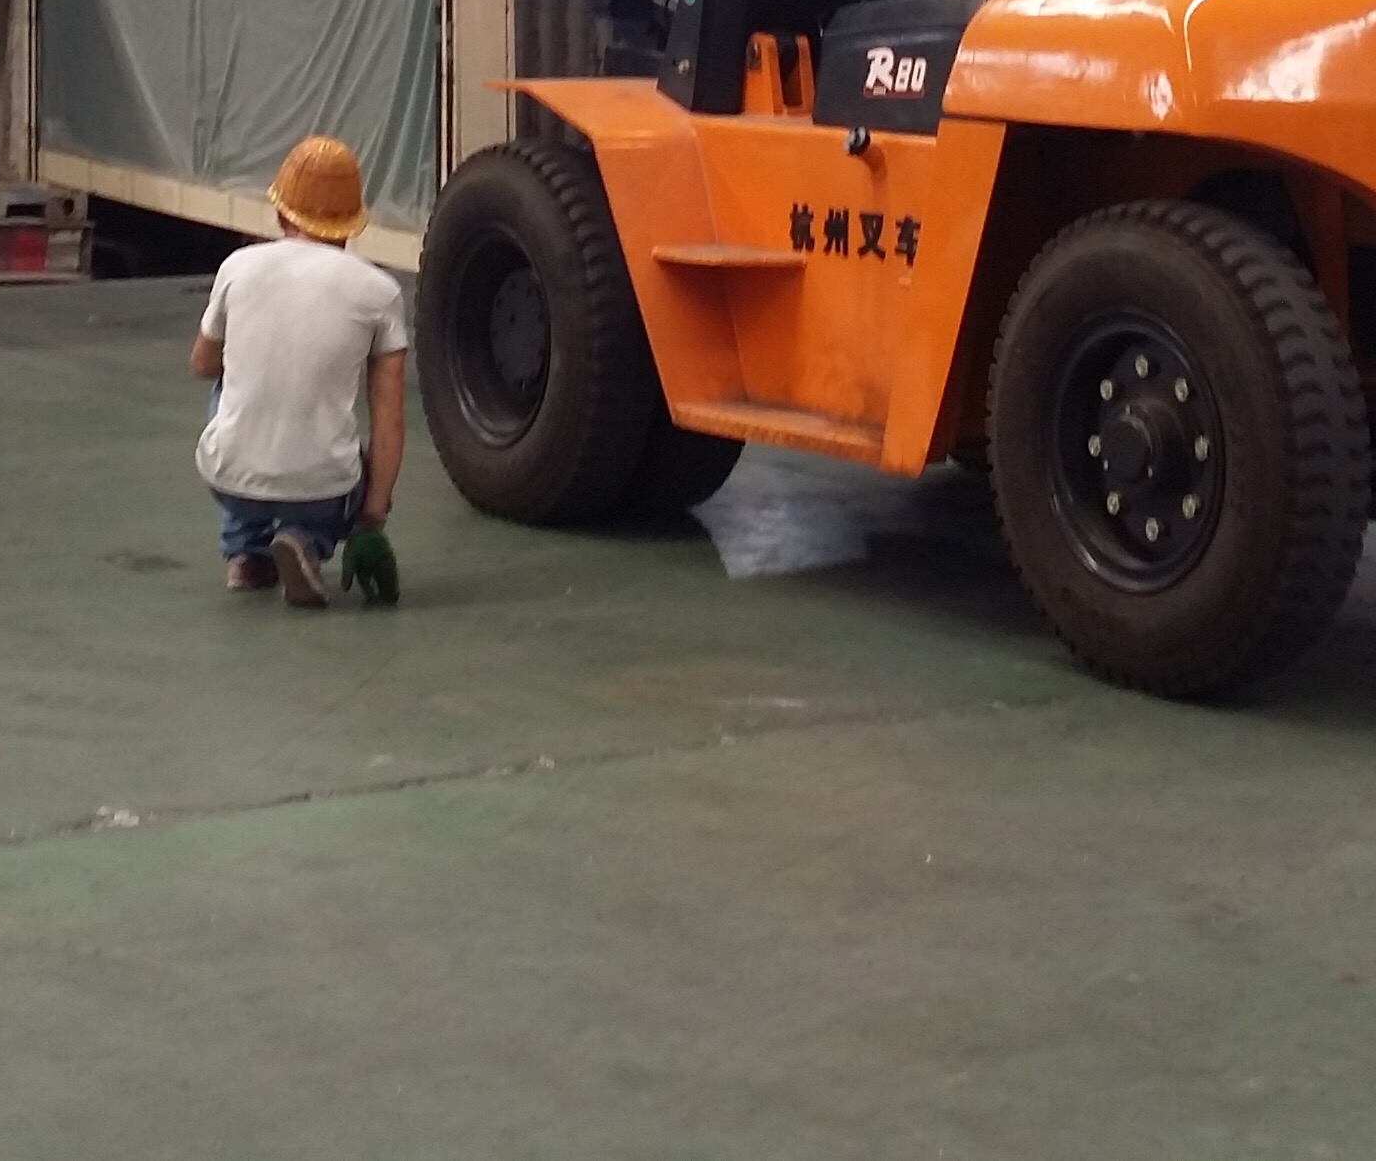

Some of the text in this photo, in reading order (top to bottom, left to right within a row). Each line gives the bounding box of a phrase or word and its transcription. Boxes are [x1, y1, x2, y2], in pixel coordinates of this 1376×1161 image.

[865, 46, 927, 93] R80
[790, 202, 922, 267] 杭州叉车
